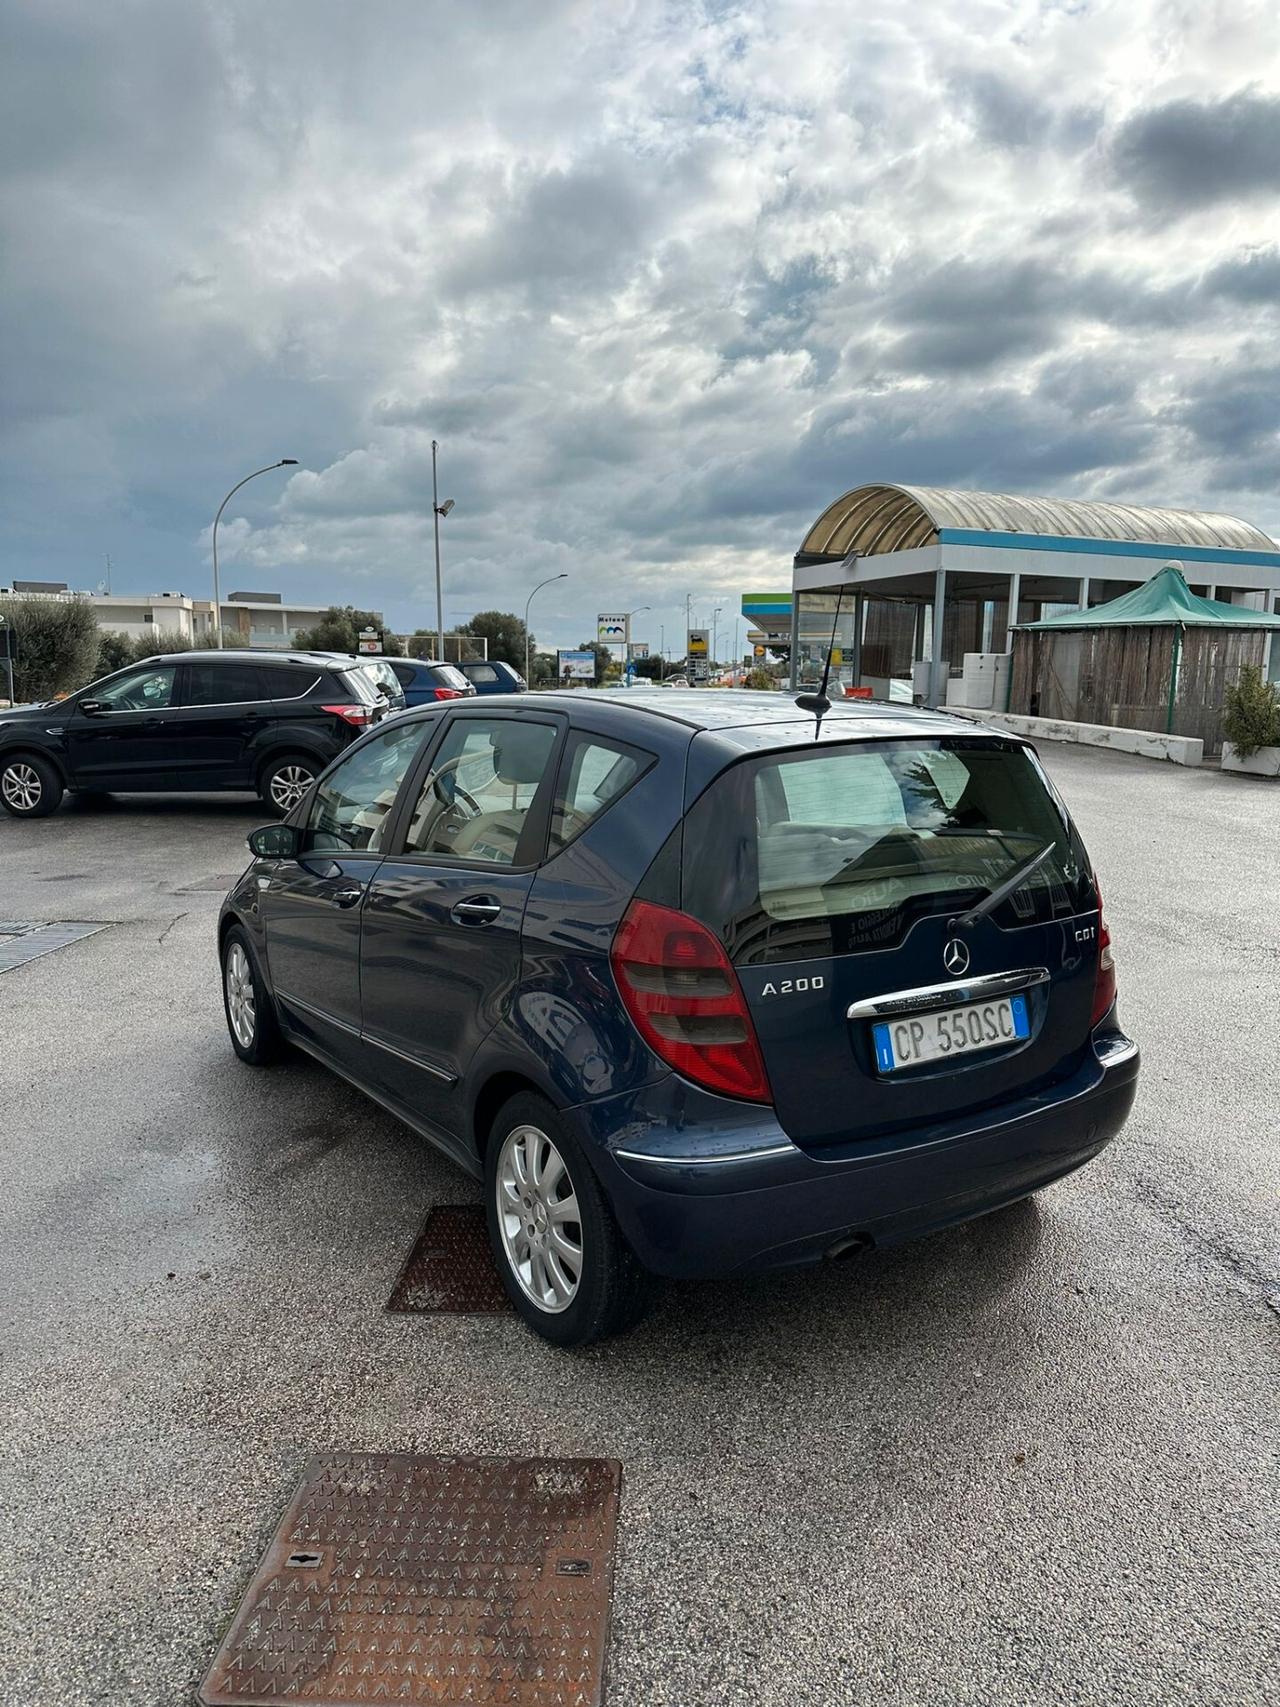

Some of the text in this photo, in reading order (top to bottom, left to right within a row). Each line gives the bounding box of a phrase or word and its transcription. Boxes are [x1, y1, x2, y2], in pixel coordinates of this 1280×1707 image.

[1075, 926, 1095, 942] CDI
[894, 1021, 924, 1061] CP
[937, 1003, 1013, 1052] 550SC
